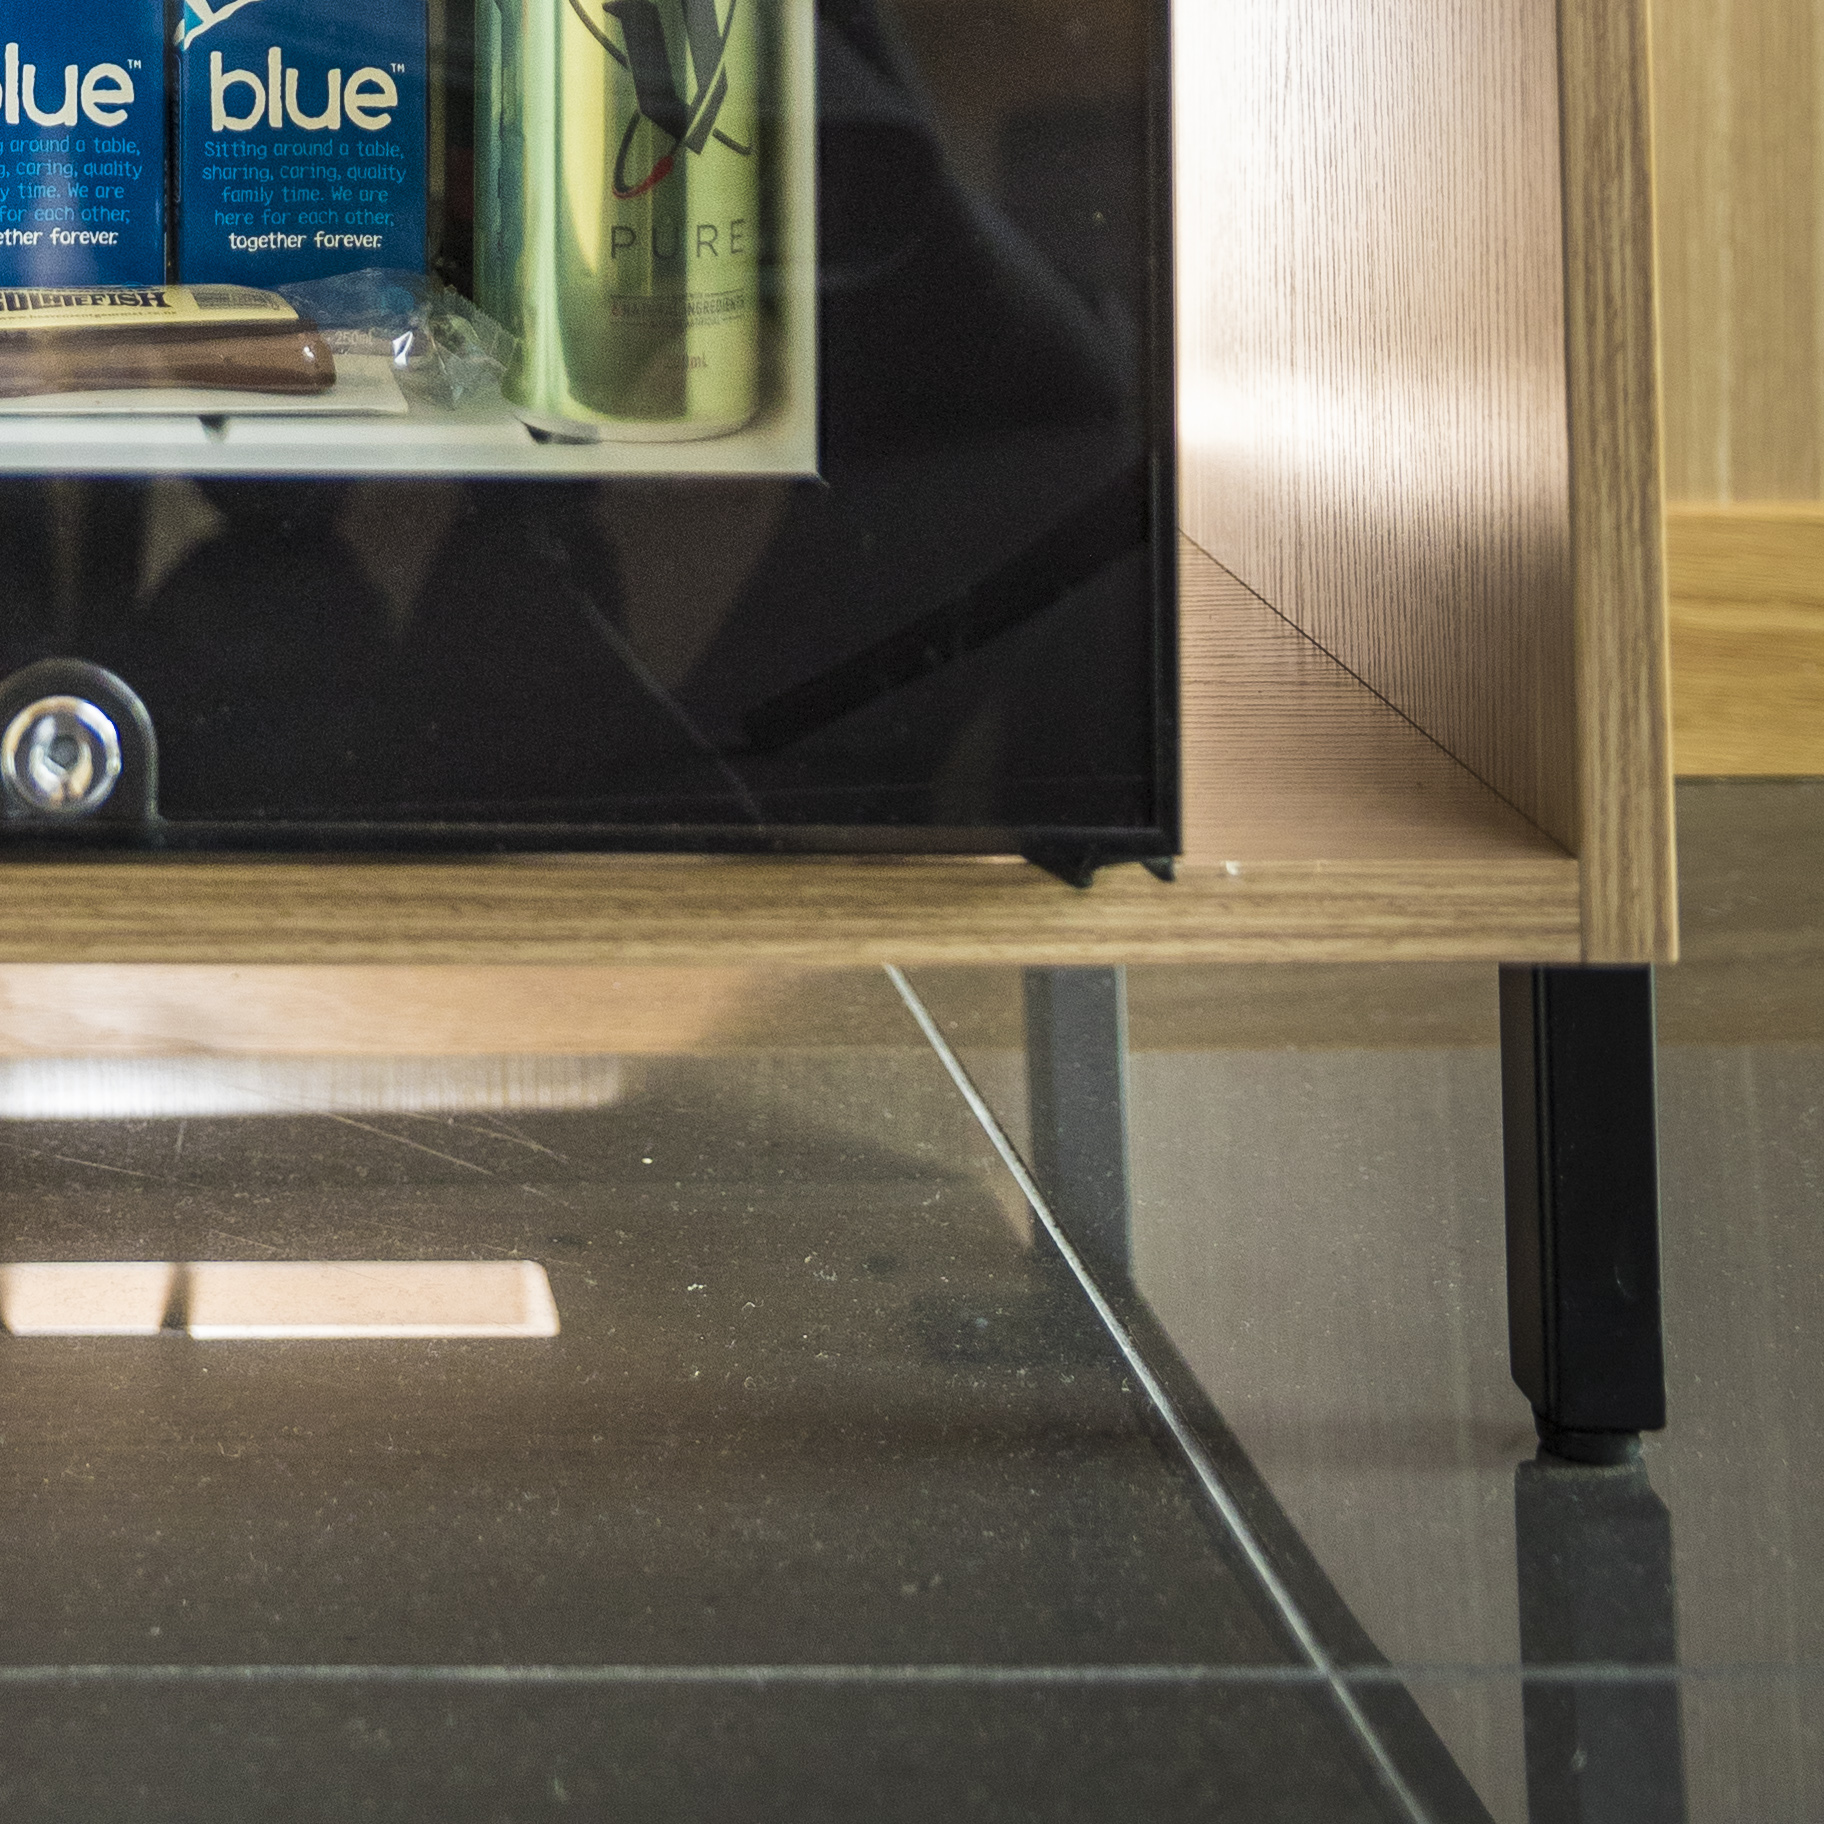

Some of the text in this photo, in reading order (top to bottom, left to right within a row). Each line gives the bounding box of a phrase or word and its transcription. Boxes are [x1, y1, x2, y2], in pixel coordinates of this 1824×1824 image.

[210, 46, 398, 132] blue
[9, 135, 71, 153] around
[76, 139, 86, 153] a
[93, 136, 142, 156] table,
[204, 139, 405, 160] Sitting around a table,
[16, 160, 79, 179] caring,
[83, 159, 143, 180] quality
[201, 163, 407, 184] sharing, caring, quality
[18, 183, 62, 200] time.
[67, 183, 89, 199] We
[95, 184, 125, 199] are
[221, 186, 389, 206] family time. We are
[33, 204, 75, 223] each
[80, 205, 131, 225] other,
[214, 208, 395, 228] here for each other,
[49, 227, 119, 245] forever.
[228, 230, 383, 252] together forever.
[610, 218, 746, 260] PURE
